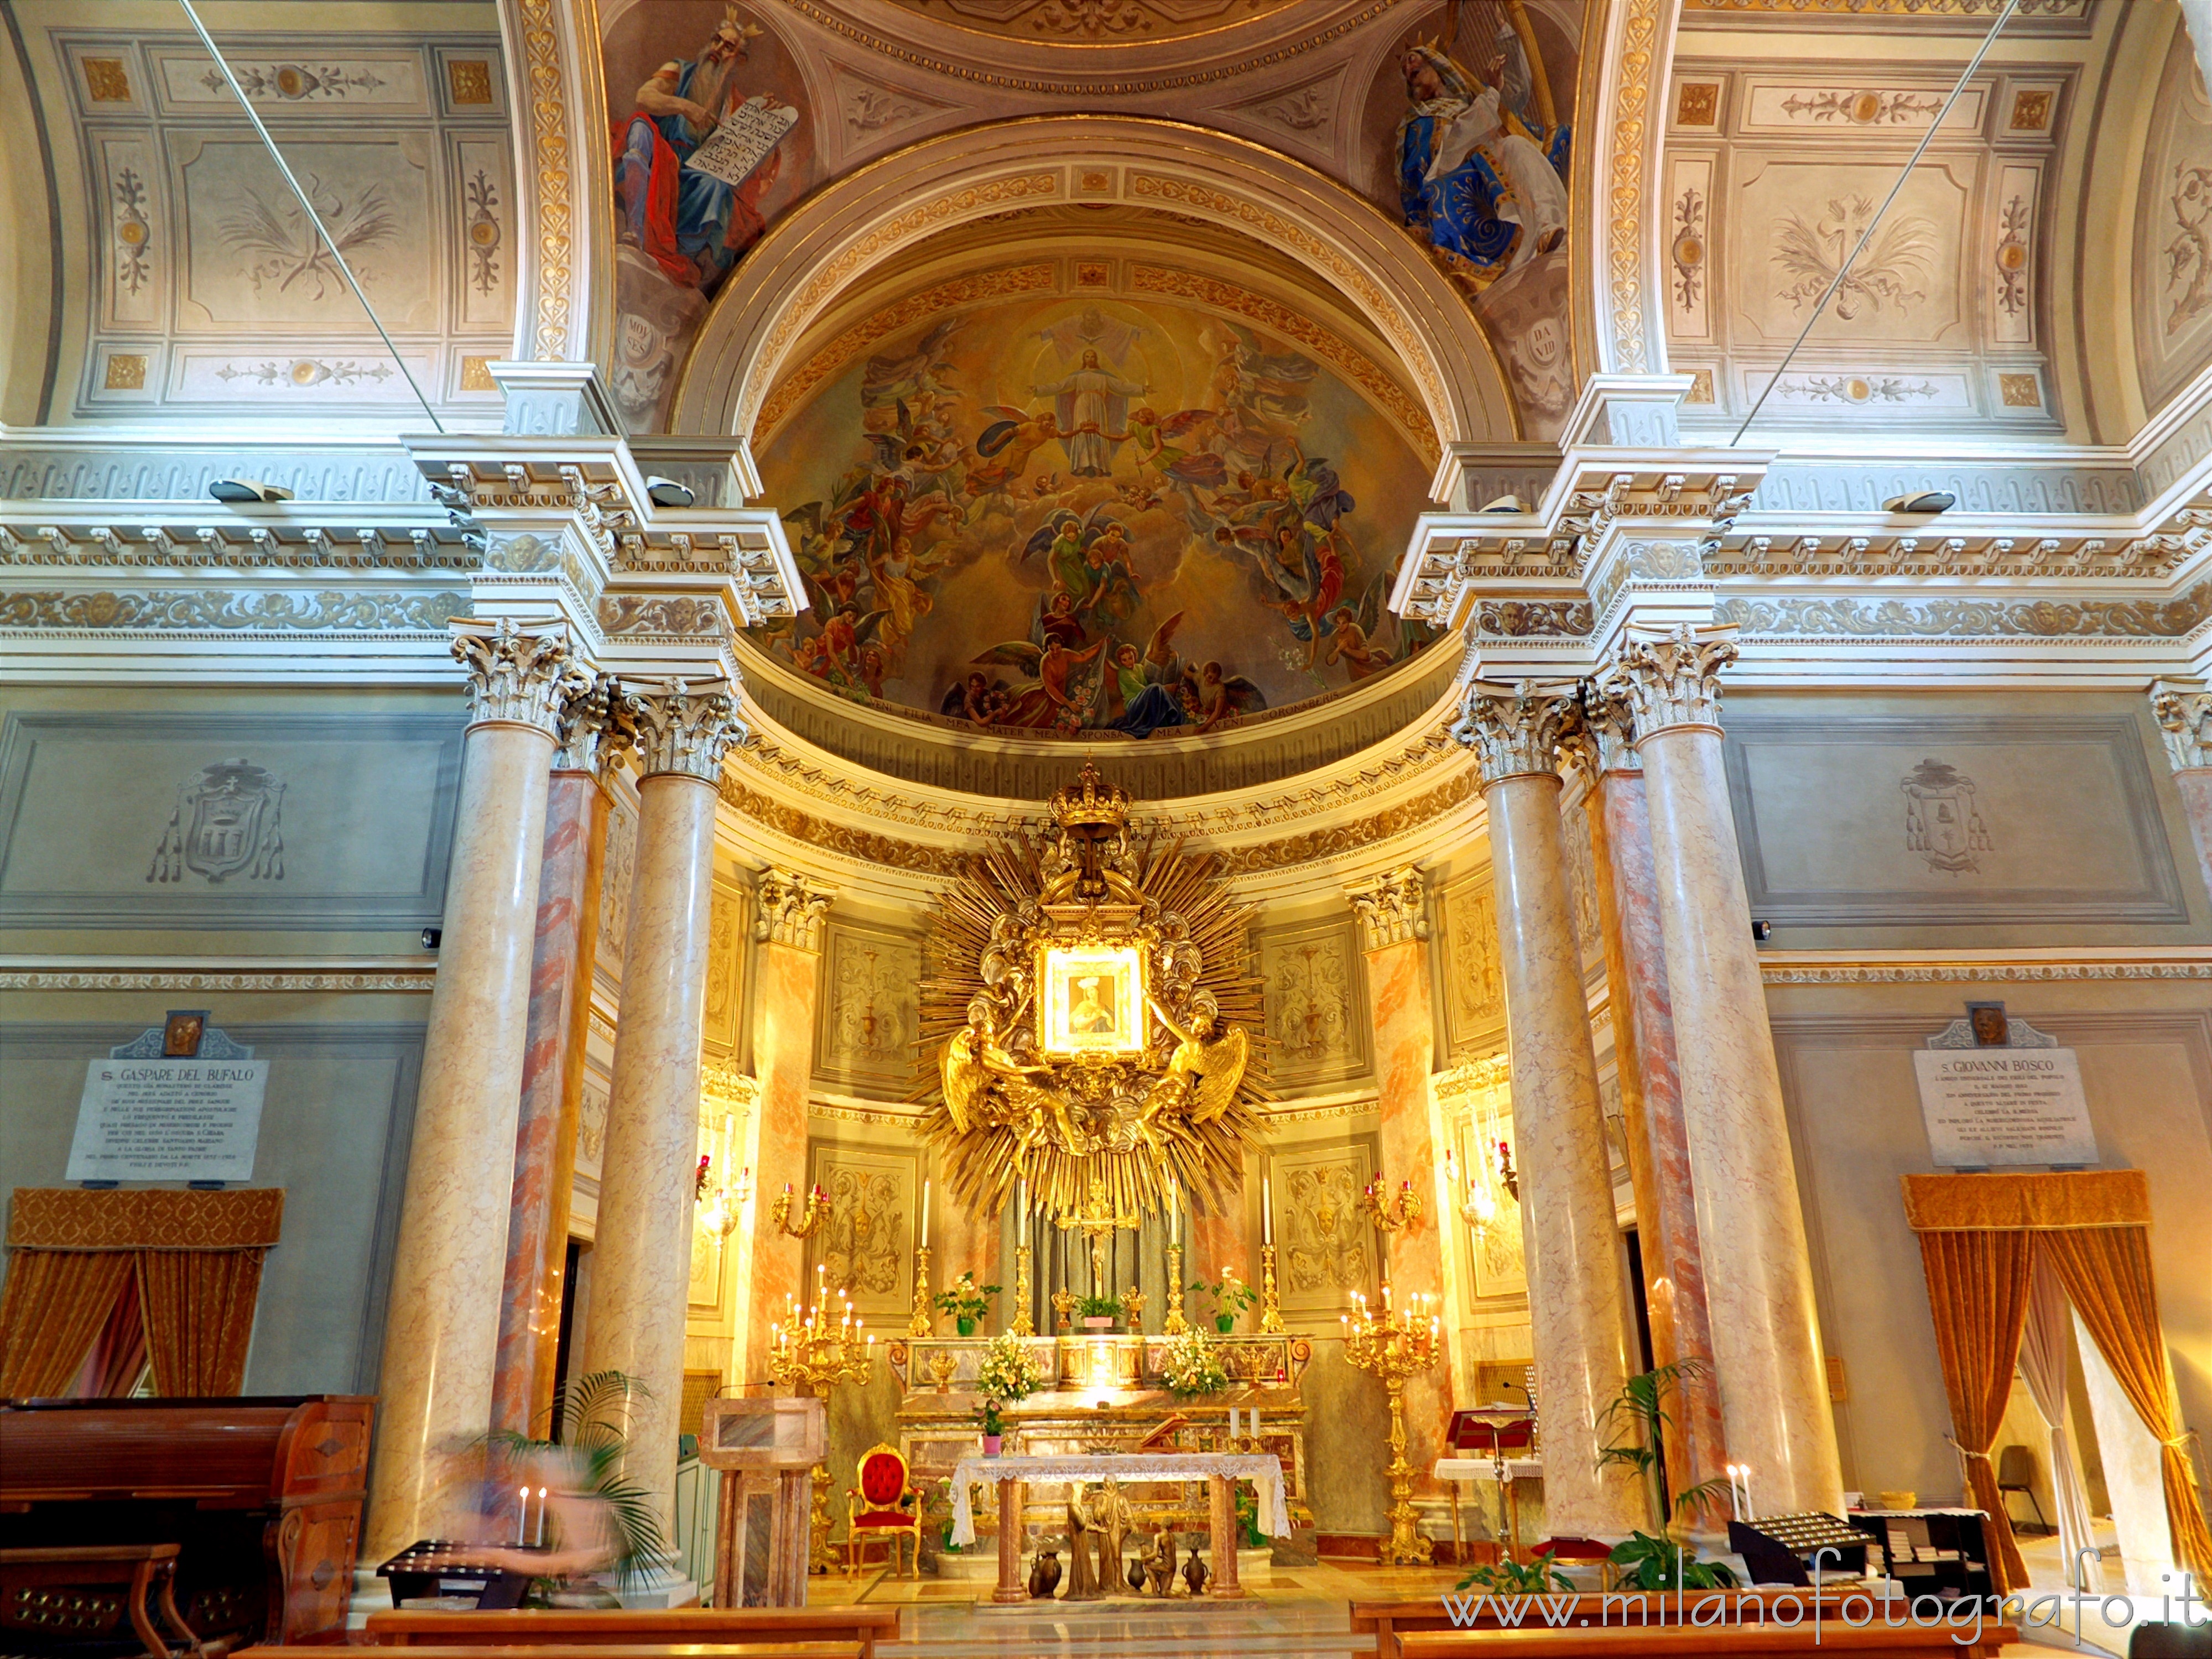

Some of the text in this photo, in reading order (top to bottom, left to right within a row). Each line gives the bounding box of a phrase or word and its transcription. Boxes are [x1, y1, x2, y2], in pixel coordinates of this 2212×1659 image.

[1534, 326, 1550, 341] DA
[1536, 341, 1554, 357] VID
[870, 697, 892, 711] VENI
[904, 709, 932, 722] FILIA
[946, 718, 970, 729] MEA
[986, 726, 1023, 736] MATER
[1035, 730, 1060, 739] MEA
[1157, 728, 1182, 737] MEA
[1214, 718, 1243, 729] VENI
[1262, 691, 1339, 721] CORONABERIS
[1953, 1061, 2008, 1072] GIOVANNI
[2013, 1061, 2054, 1071] BOSCO
[121, 1069, 174, 1081] GASPARE
[178, 1069, 200, 1081] DEL
[207, 1069, 254, 1081] BUFALO
